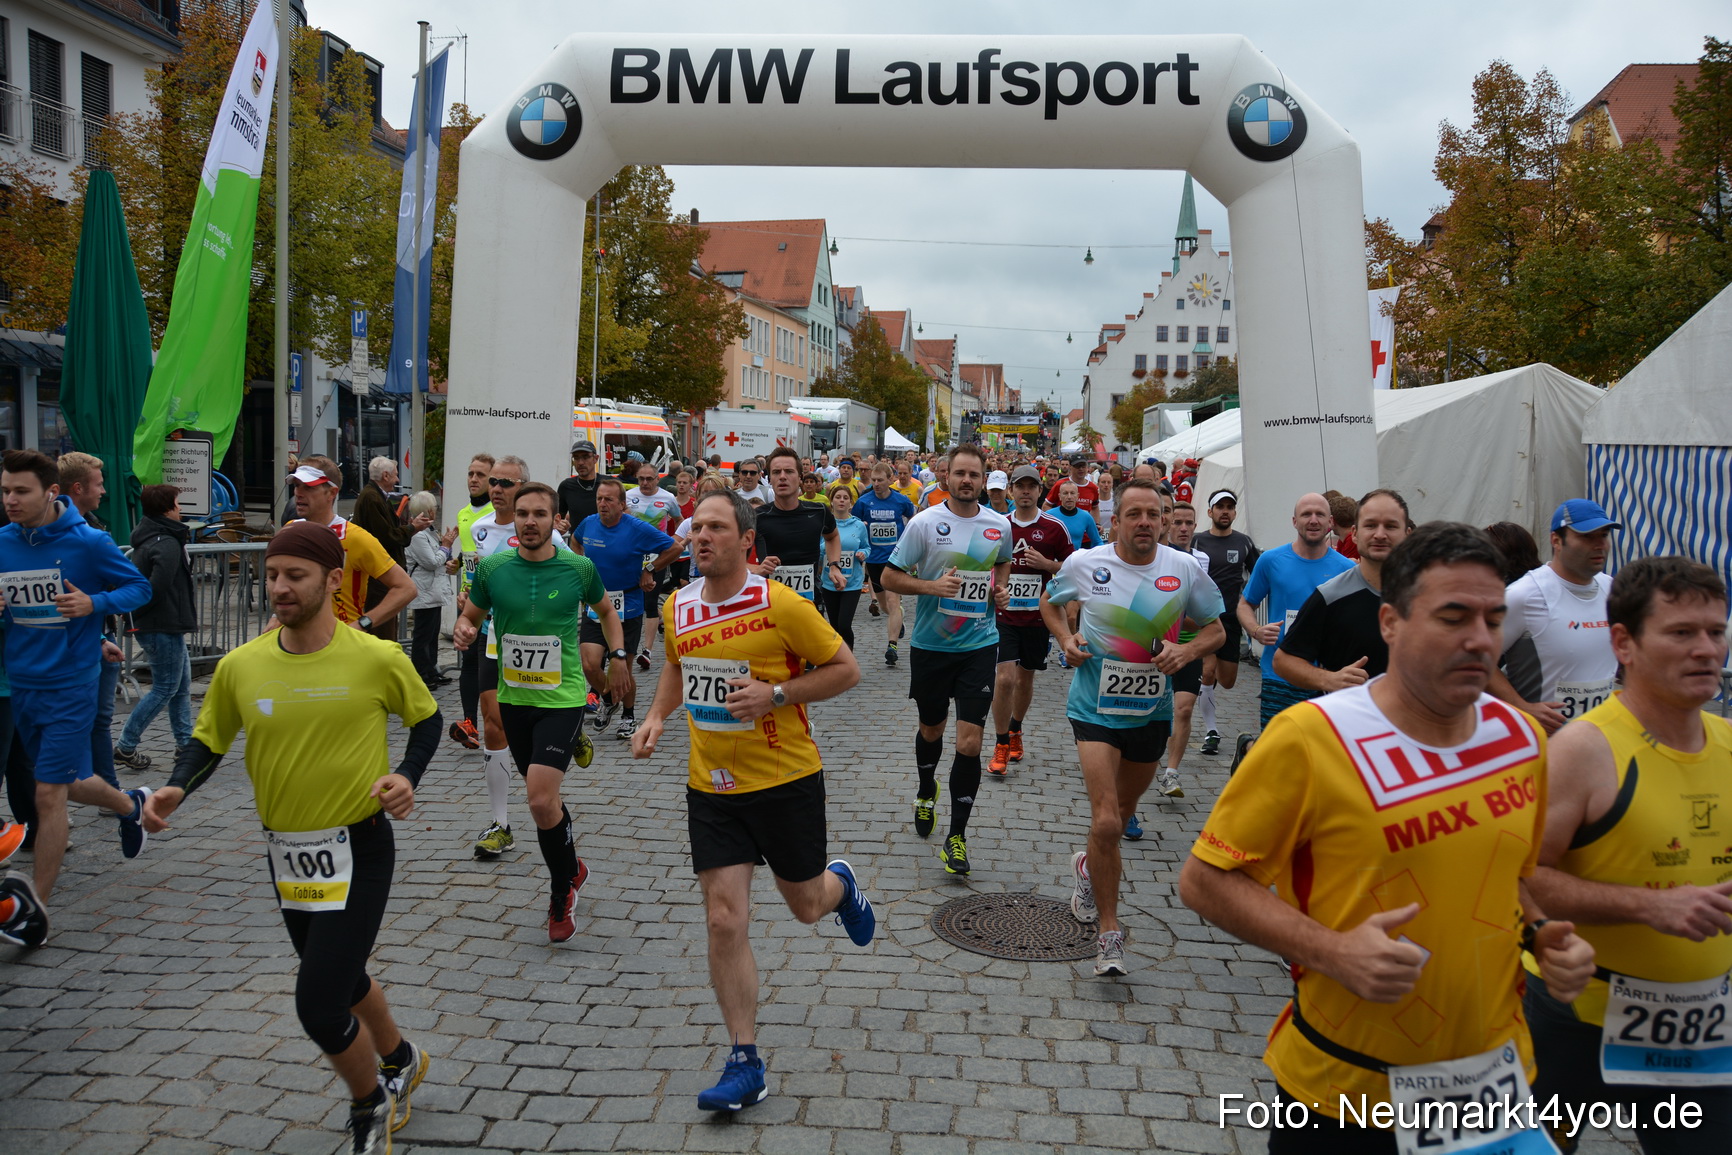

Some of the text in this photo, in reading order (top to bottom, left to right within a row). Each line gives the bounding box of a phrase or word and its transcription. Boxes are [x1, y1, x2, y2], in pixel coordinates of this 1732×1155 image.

[610, 47, 1201, 120] BMW Laufsport
[516, 84, 577, 110] BMW
[1234, 84, 1299, 112] BMW
[448, 406, 551, 420] www.bmw-laufsport.de
[1263, 413, 1374, 428] www.bmw-laufsport.de
[180, 447, 208, 457] Richtung
[185, 467, 200, 475] über
[166, 475, 188, 483] Untere
[870, 509, 895, 517] HUBER
[872, 527, 895, 537] 2056
[1008, 583, 1039, 597] 2627
[1157, 579, 1179, 588] Hervis
[7, 582, 58, 604] 2108
[23, 608, 50, 616] Tobias
[953, 601, 977, 613] Timmy
[502, 637, 520, 646] PARTL
[676, 615, 777, 658] MAX BÖGL
[512, 648, 550, 670] 377
[682, 662, 736, 674] PARTL Neumarkt
[1103, 663, 1126, 674] PARTL
[517, 672, 544, 683] Tobias
[1106, 674, 1160, 696] 2225
[1556, 686, 1583, 695] PARTL
[1113, 698, 1149, 709] Andreas
[1561, 694, 1609, 719] 310
[695, 707, 735, 722] Matthias
[1382, 800, 1480, 854] MAX
[290, 838, 333, 848] Neumarkt
[283, 849, 336, 879] 100
[293, 886, 325, 899] Tobias
[1613, 985, 1719, 1004] PARTL Neumarkt
[1619, 1003, 1726, 1045] 2682
[1644, 1051, 1693, 1069] Klaus
[1394, 1075, 1449, 1091] PARTL
